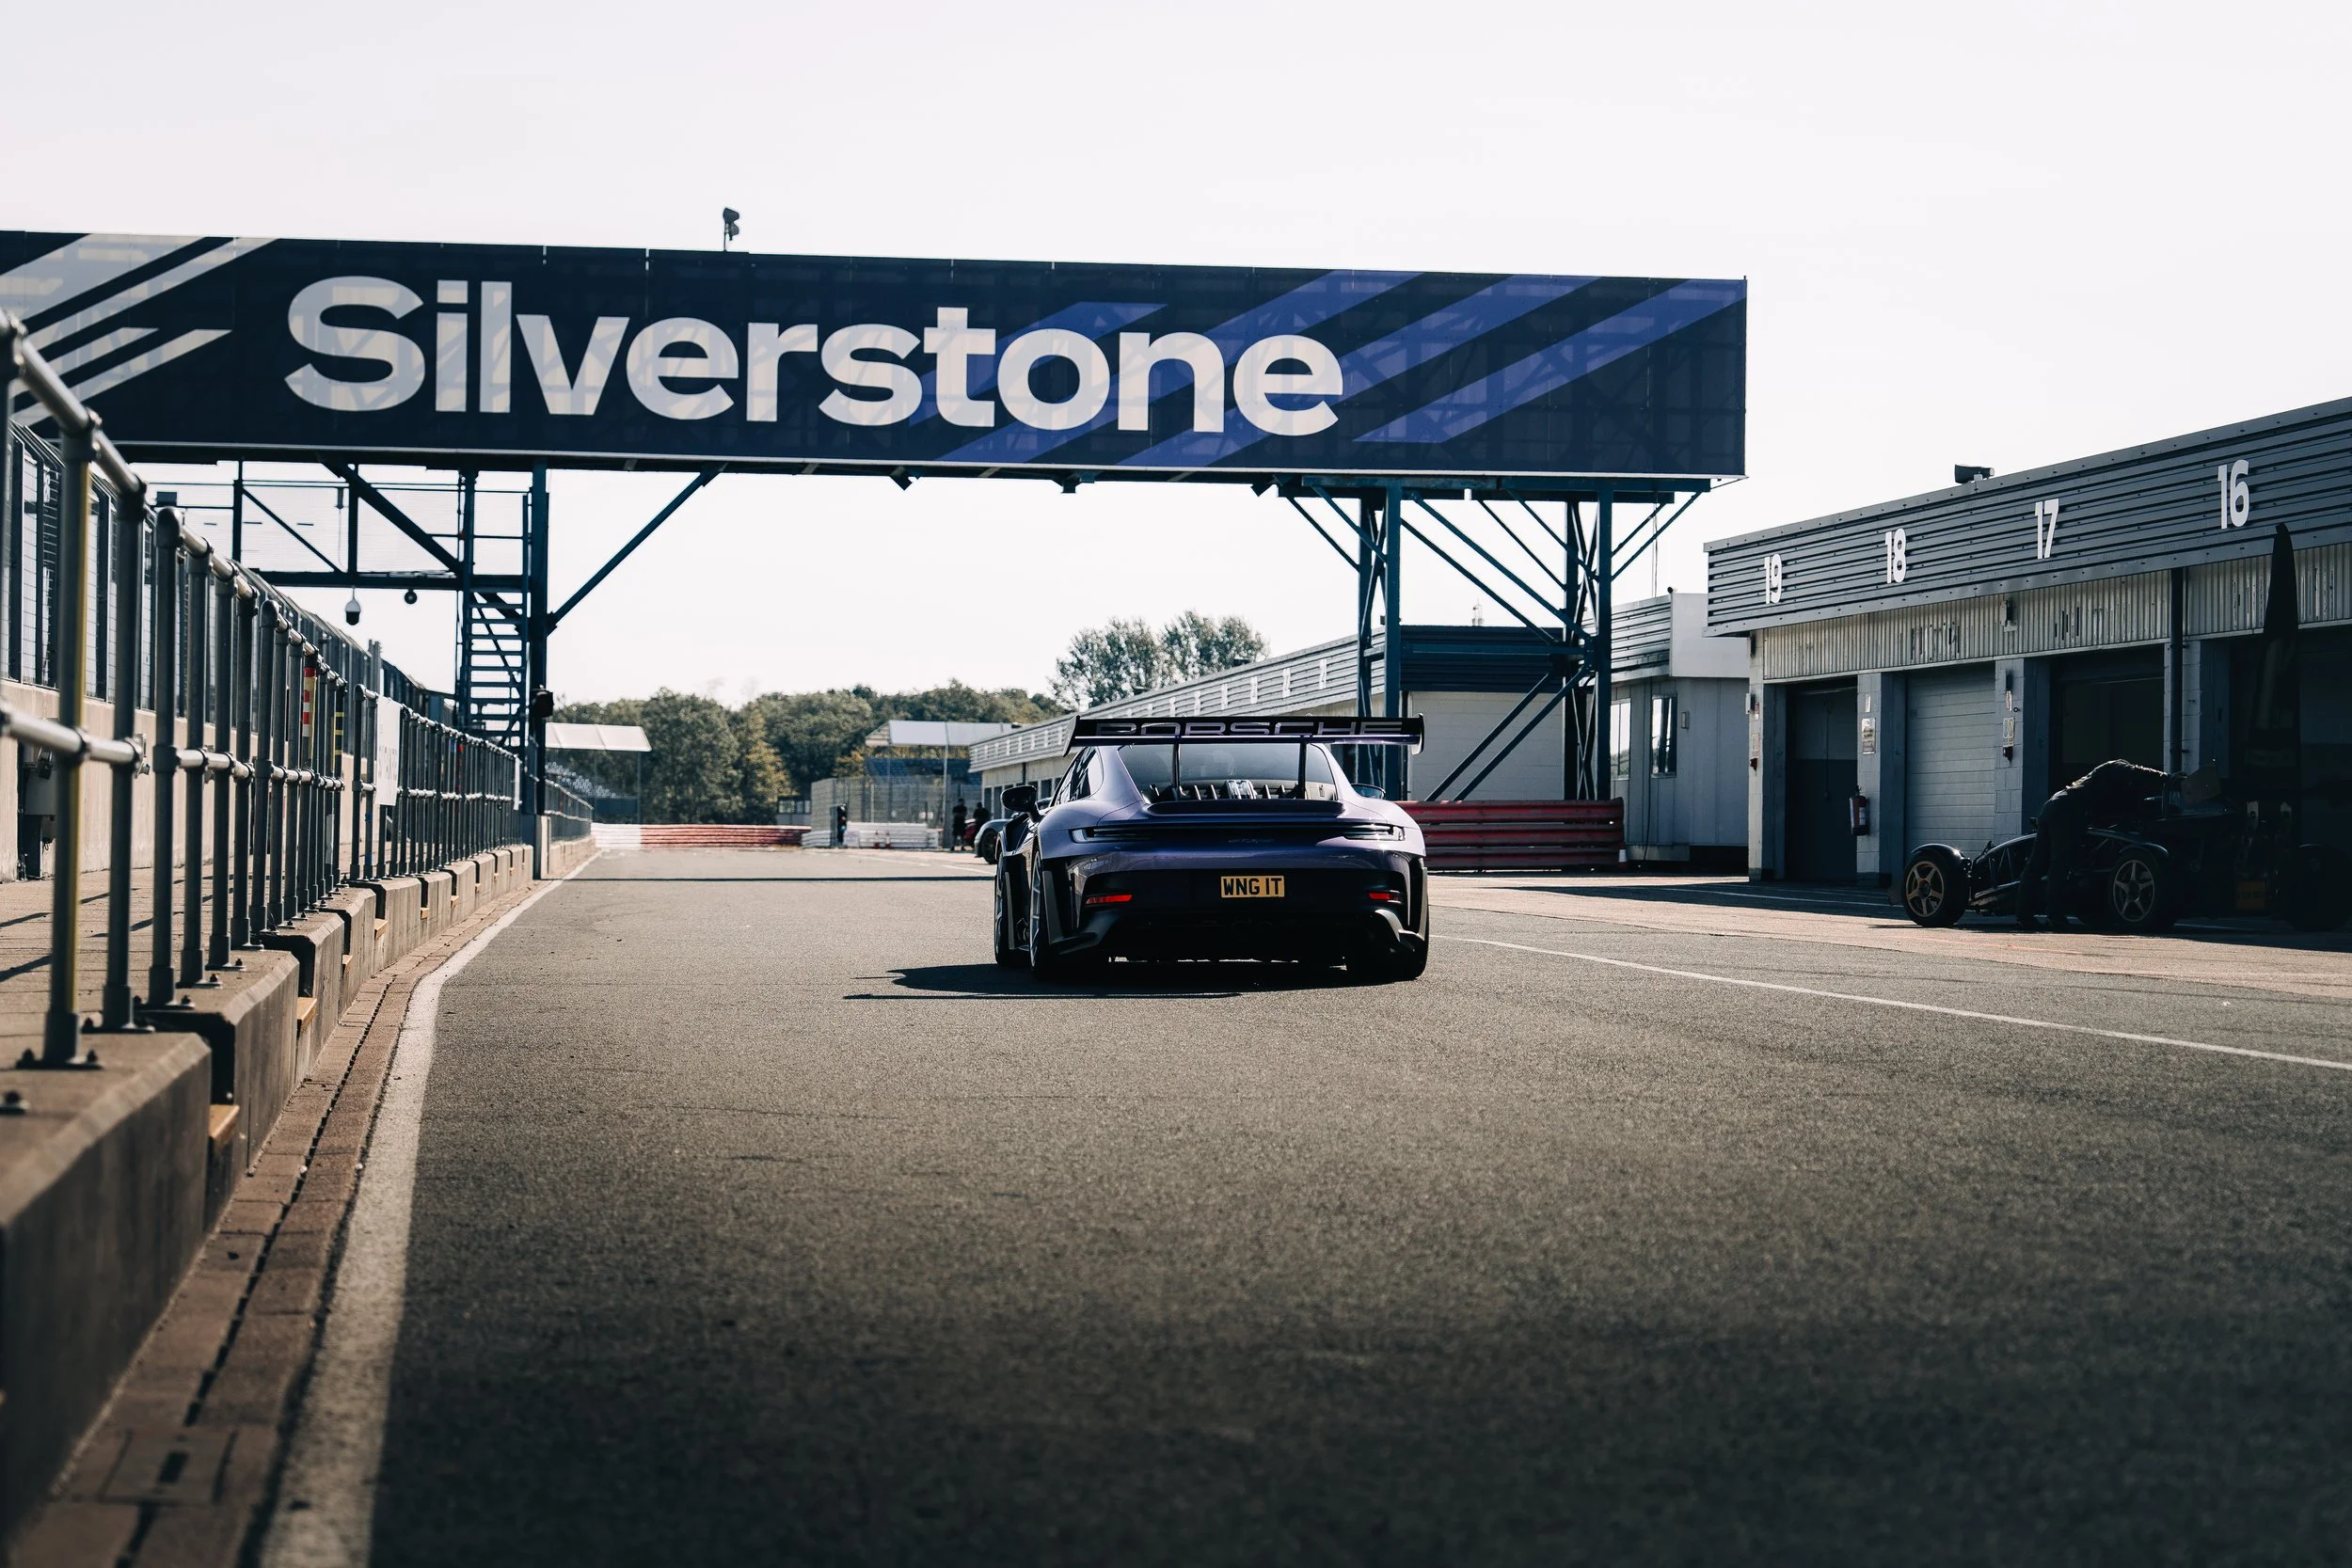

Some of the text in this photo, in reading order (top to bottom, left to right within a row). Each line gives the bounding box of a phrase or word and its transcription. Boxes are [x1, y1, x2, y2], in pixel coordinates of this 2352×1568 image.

[284, 276, 1343, 436] Silverstone
[2217, 459, 2249, 530] 16
[1884, 528, 1906, 584] 18
[2034, 498, 2059, 560] 17
[1764, 553, 1782, 605] 19
[1095, 721, 1403, 736] PORSCHE
[1223, 878, 1261, 896] WNG
